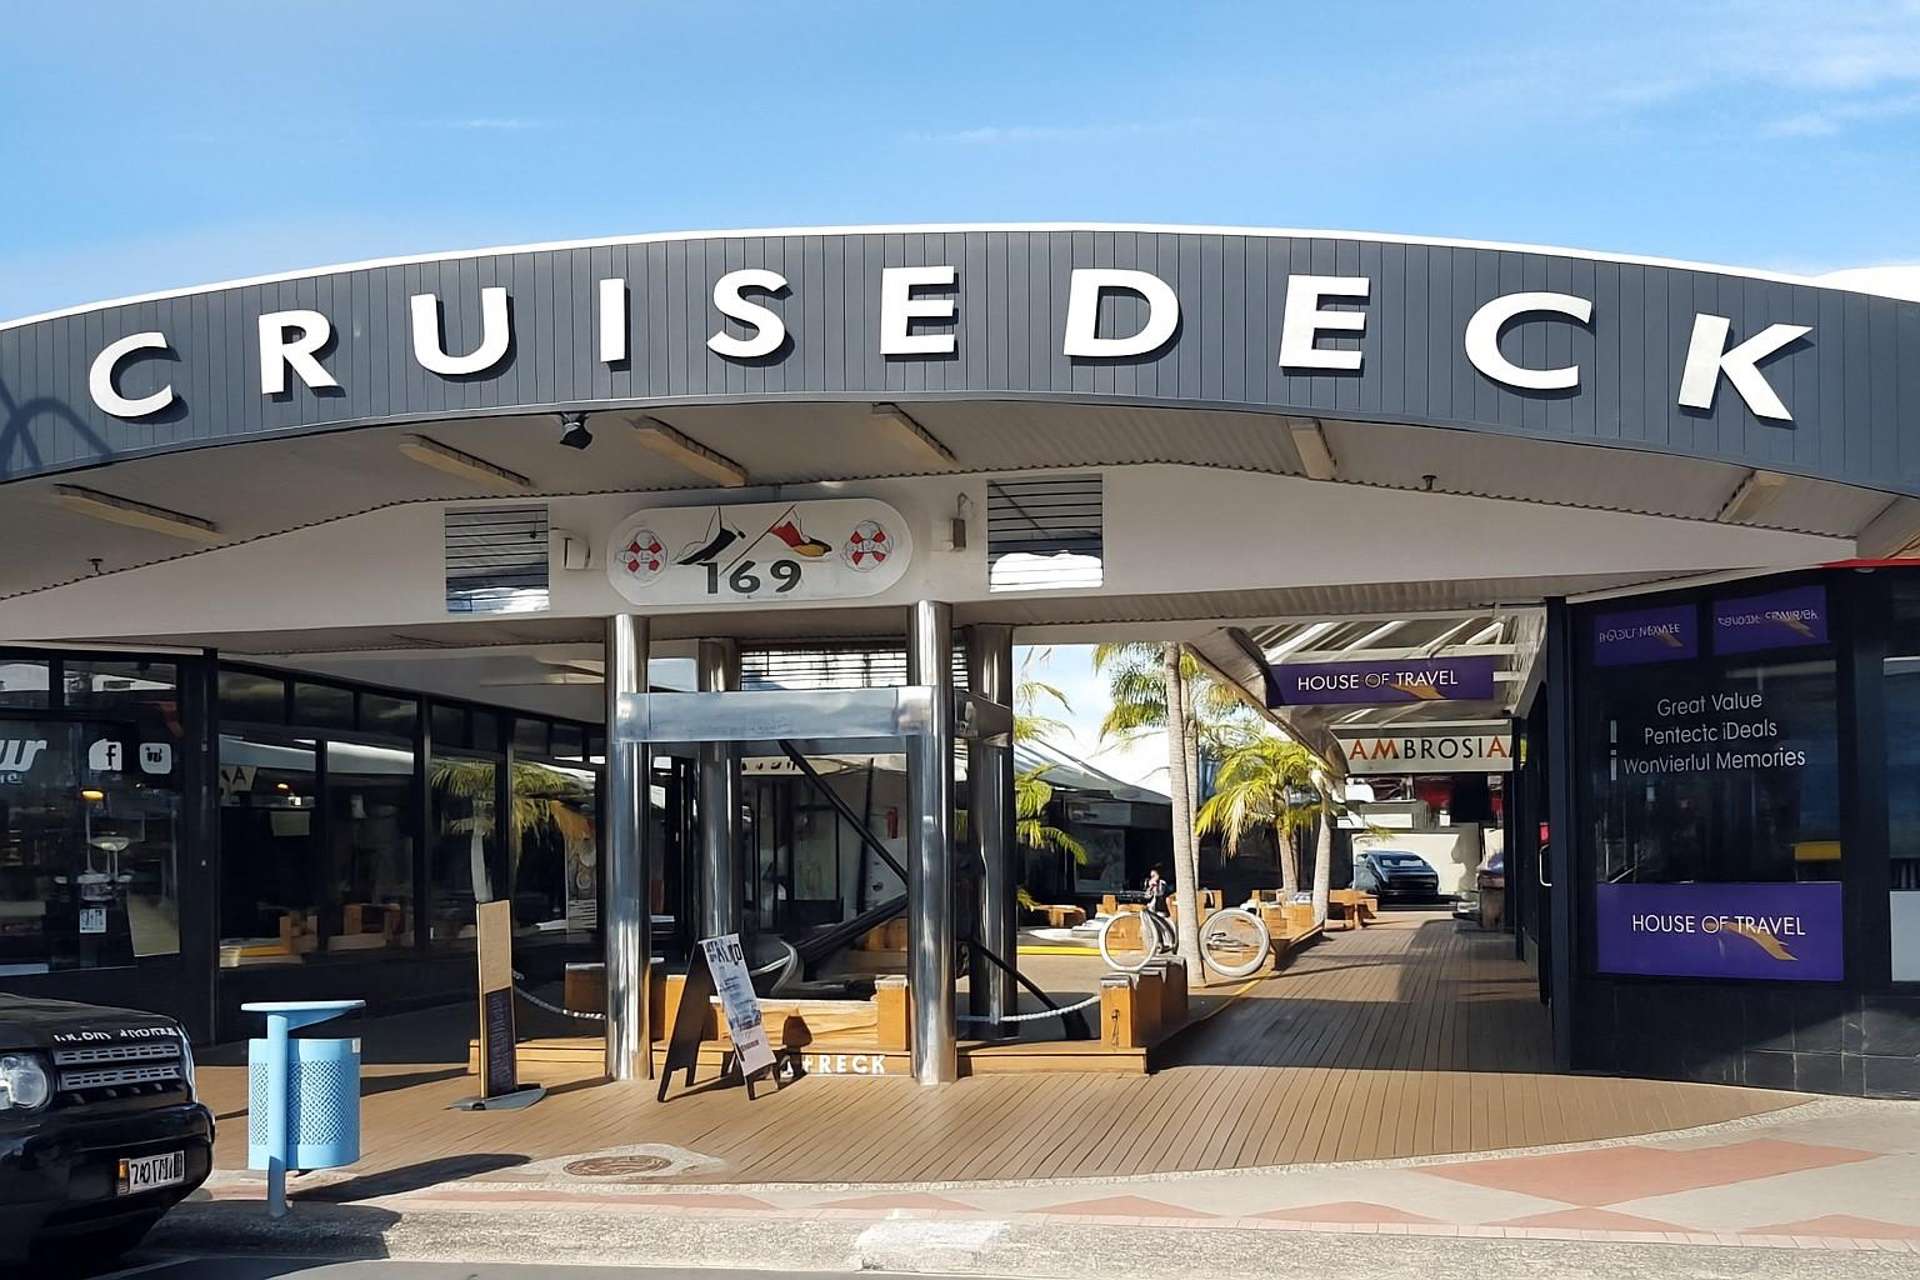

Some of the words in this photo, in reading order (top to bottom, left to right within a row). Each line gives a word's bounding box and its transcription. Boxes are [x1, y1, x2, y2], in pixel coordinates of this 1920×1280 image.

[1297, 674, 1360, 691] HOUSE
[1364, 673, 1390, 688] OF
[1396, 670, 1459, 687] TRAVEL
[1656, 696, 1706, 717] Great
[1711, 692, 1763, 711] Value
[1349, 735, 1509, 761] AMBROSIA
[1715, 747, 1807, 770] Memories
[1632, 914, 1696, 934] HOUSE
[1701, 915, 1730, 934] OF
[1734, 915, 1807, 936] TRAVEL
